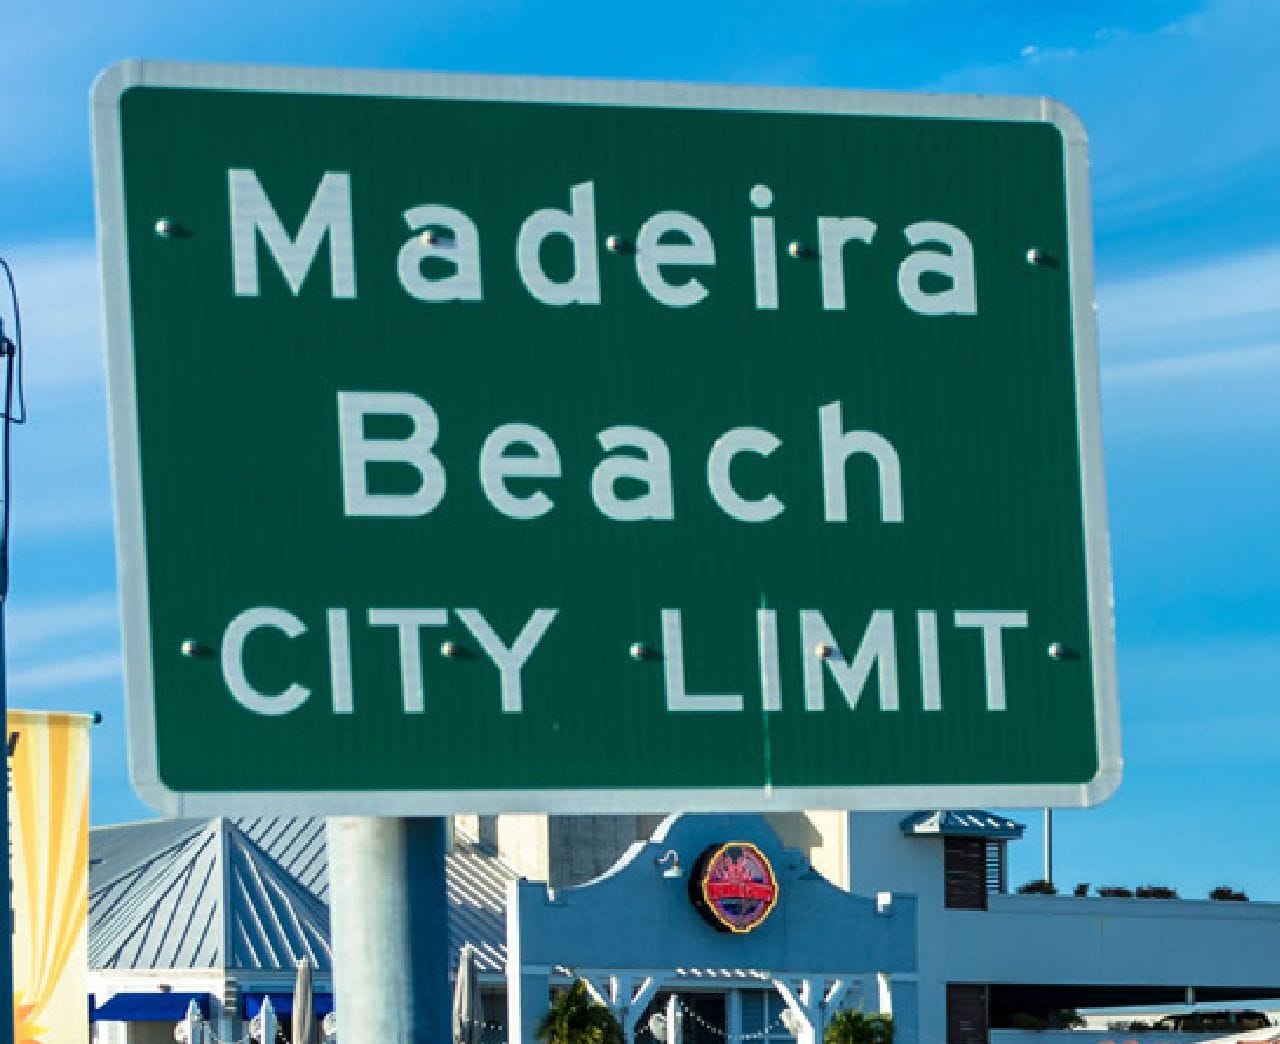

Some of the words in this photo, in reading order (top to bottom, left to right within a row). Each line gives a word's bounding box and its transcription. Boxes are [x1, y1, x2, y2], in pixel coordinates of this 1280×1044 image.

[226, 167, 979, 317] Madeira
[336, 390, 905, 525] Beach
[220, 606, 559, 717] CITY
[660, 608, 1030, 713] LIMIT
